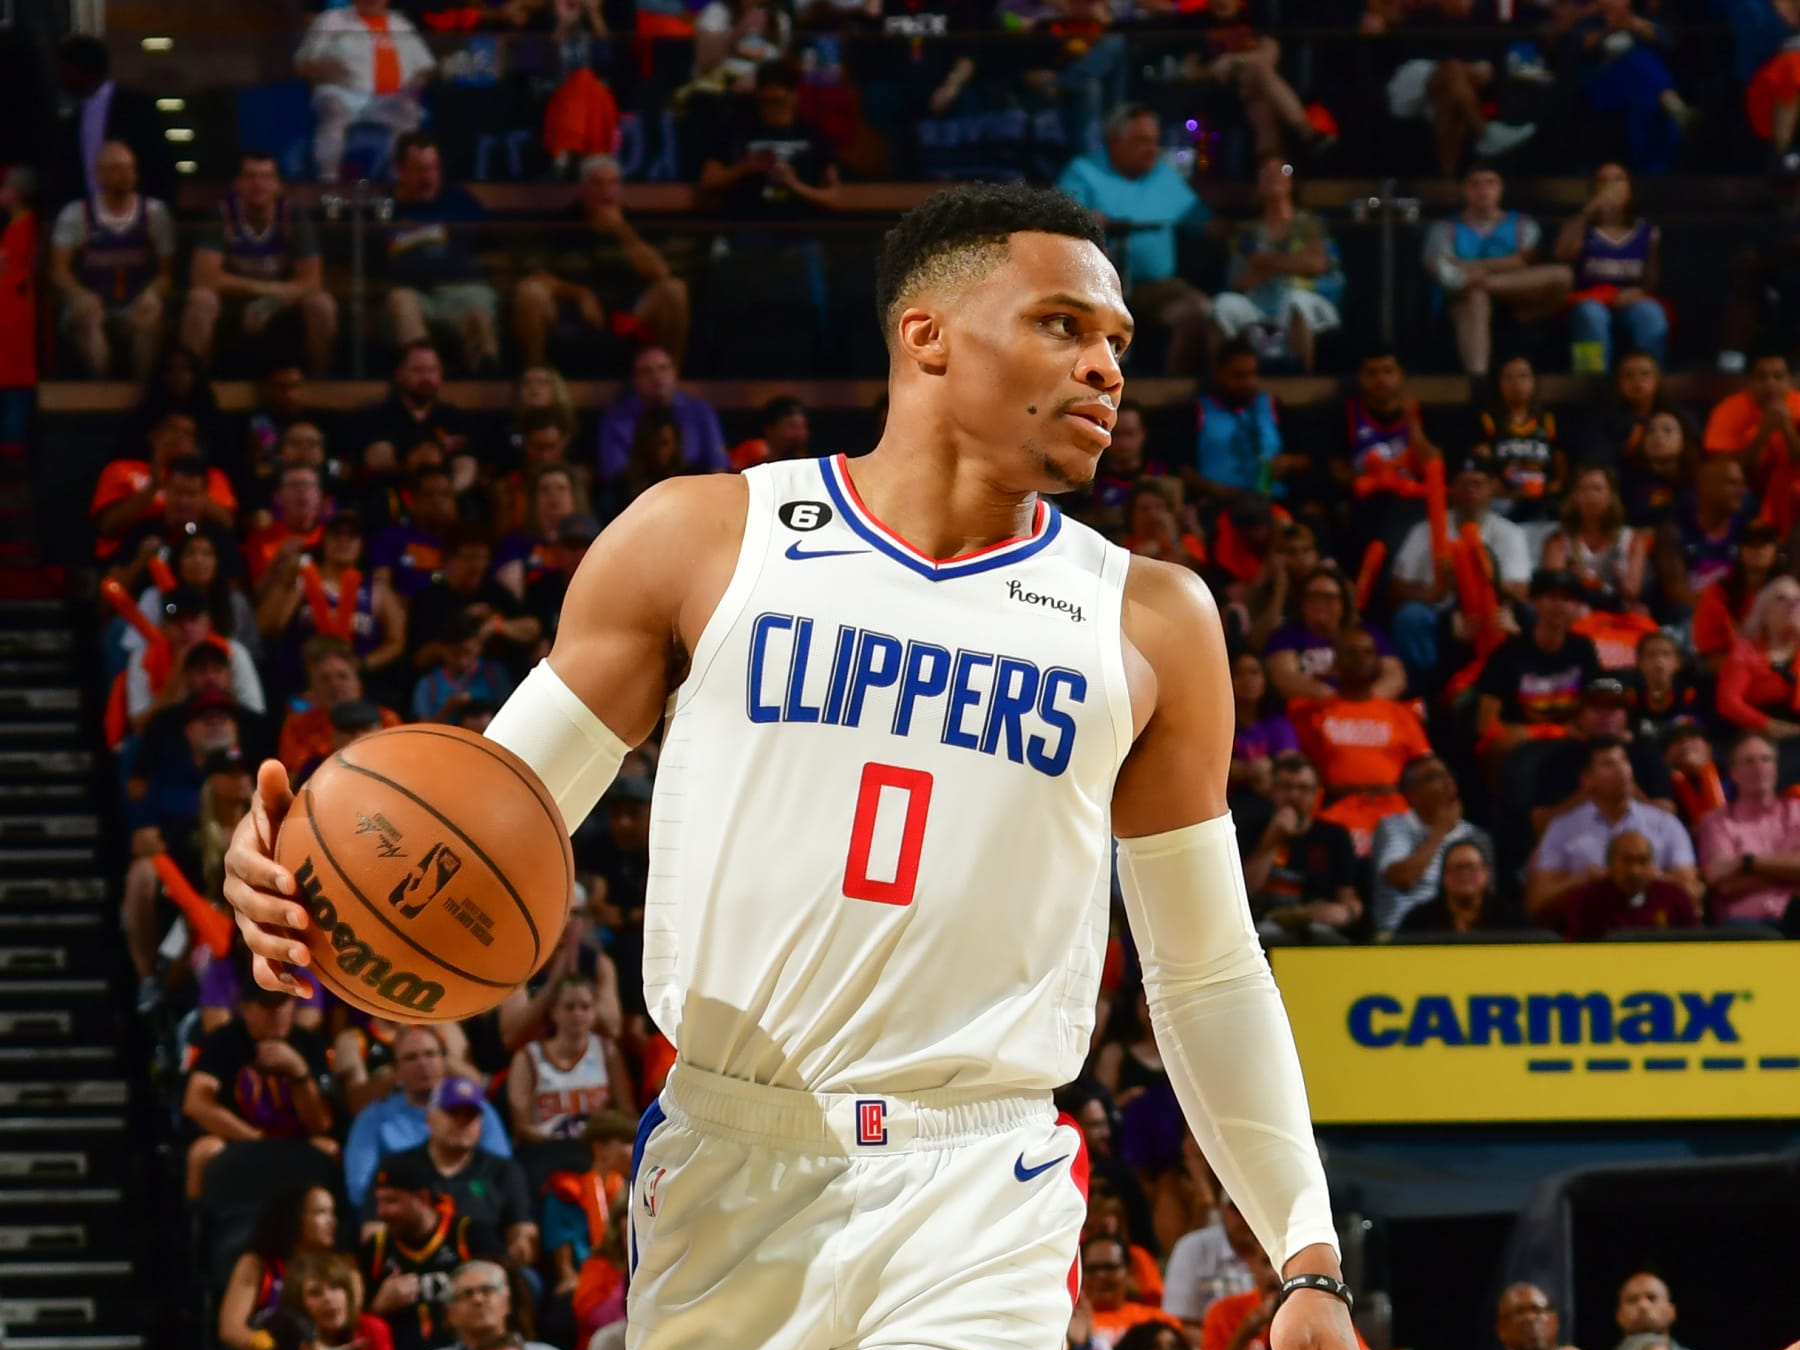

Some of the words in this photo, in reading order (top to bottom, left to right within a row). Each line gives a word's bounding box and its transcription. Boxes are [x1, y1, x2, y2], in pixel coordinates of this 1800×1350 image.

[789, 504, 820, 530] 6
[1006, 580, 1086, 622] honey
[746, 611, 1088, 778] CLIPPERS
[842, 761, 934, 906] 0
